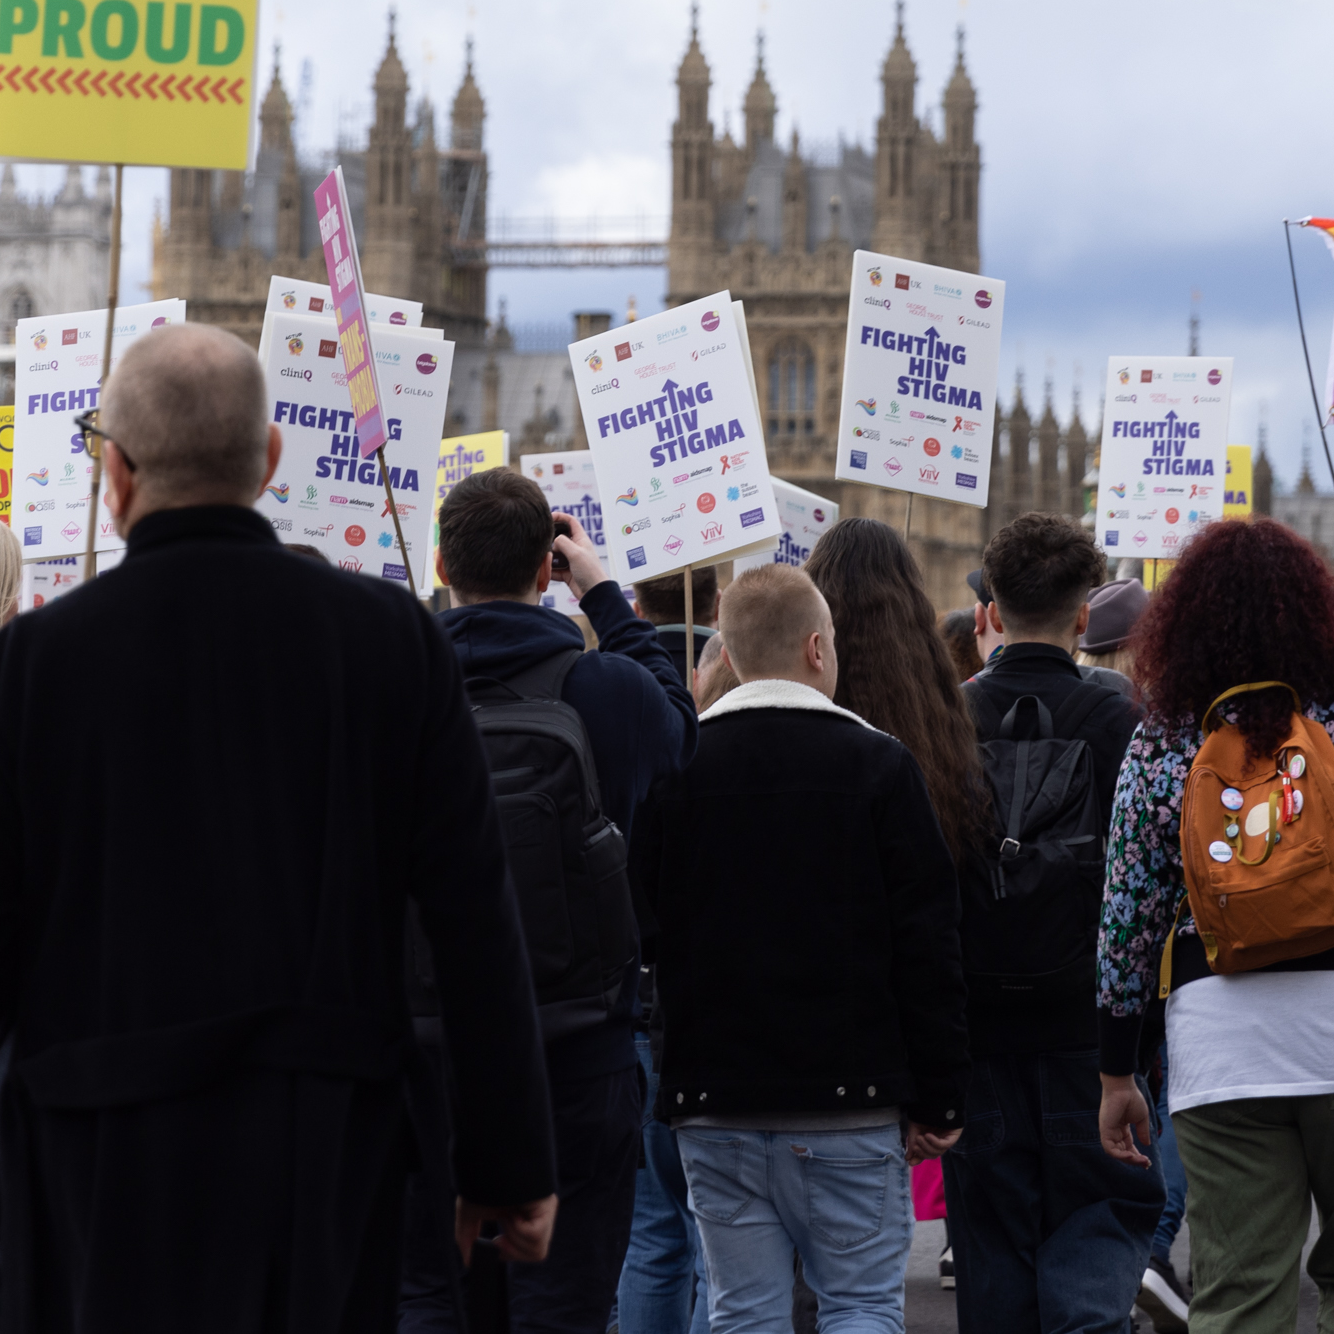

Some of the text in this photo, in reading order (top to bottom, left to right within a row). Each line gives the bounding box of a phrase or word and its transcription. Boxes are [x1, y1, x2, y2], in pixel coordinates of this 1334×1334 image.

[966, 319, 990, 329] GILEAD
[79, 331, 91, 339] UK
[656, 329, 681, 341] BHIVA
[631, 342, 645, 352] UK
[700, 343, 727, 357] GILEAD
[861, 325, 966, 365] FIGHTING
[29, 360, 59, 373] cliniQ
[634, 363, 657, 376] GEORGE
[658, 362, 677, 373] TRUST
[908, 356, 949, 382] HIV
[280, 367, 313, 382] cliniQ
[404, 387, 433, 398] GILEAD
[591, 378, 620, 395] cliniQ
[897, 375, 982, 411] STIGMA
[27, 387, 100, 415] FIGHT
[598, 381, 713, 438] FIGHTING
[274, 400, 402, 441] FIGHTG
[655, 408, 698, 442] HIV
[1112, 421, 1200, 439] FIGHTING
[650, 418, 745, 468] STIGMA
[1152, 440, 1186, 457] HIV
[437, 449, 484, 469] HTING
[315, 456, 419, 491] STIGMA
[1142, 458, 1215, 476] STIGMA
[66, 501, 86, 510] Sophia
[349, 499, 374, 508] aidsmap
[661, 513, 681, 523] Sophia
[303, 528, 325, 537] Sophia
[701, 524, 723, 540] ViiV
[384, 570, 406, 578] MESMAC
